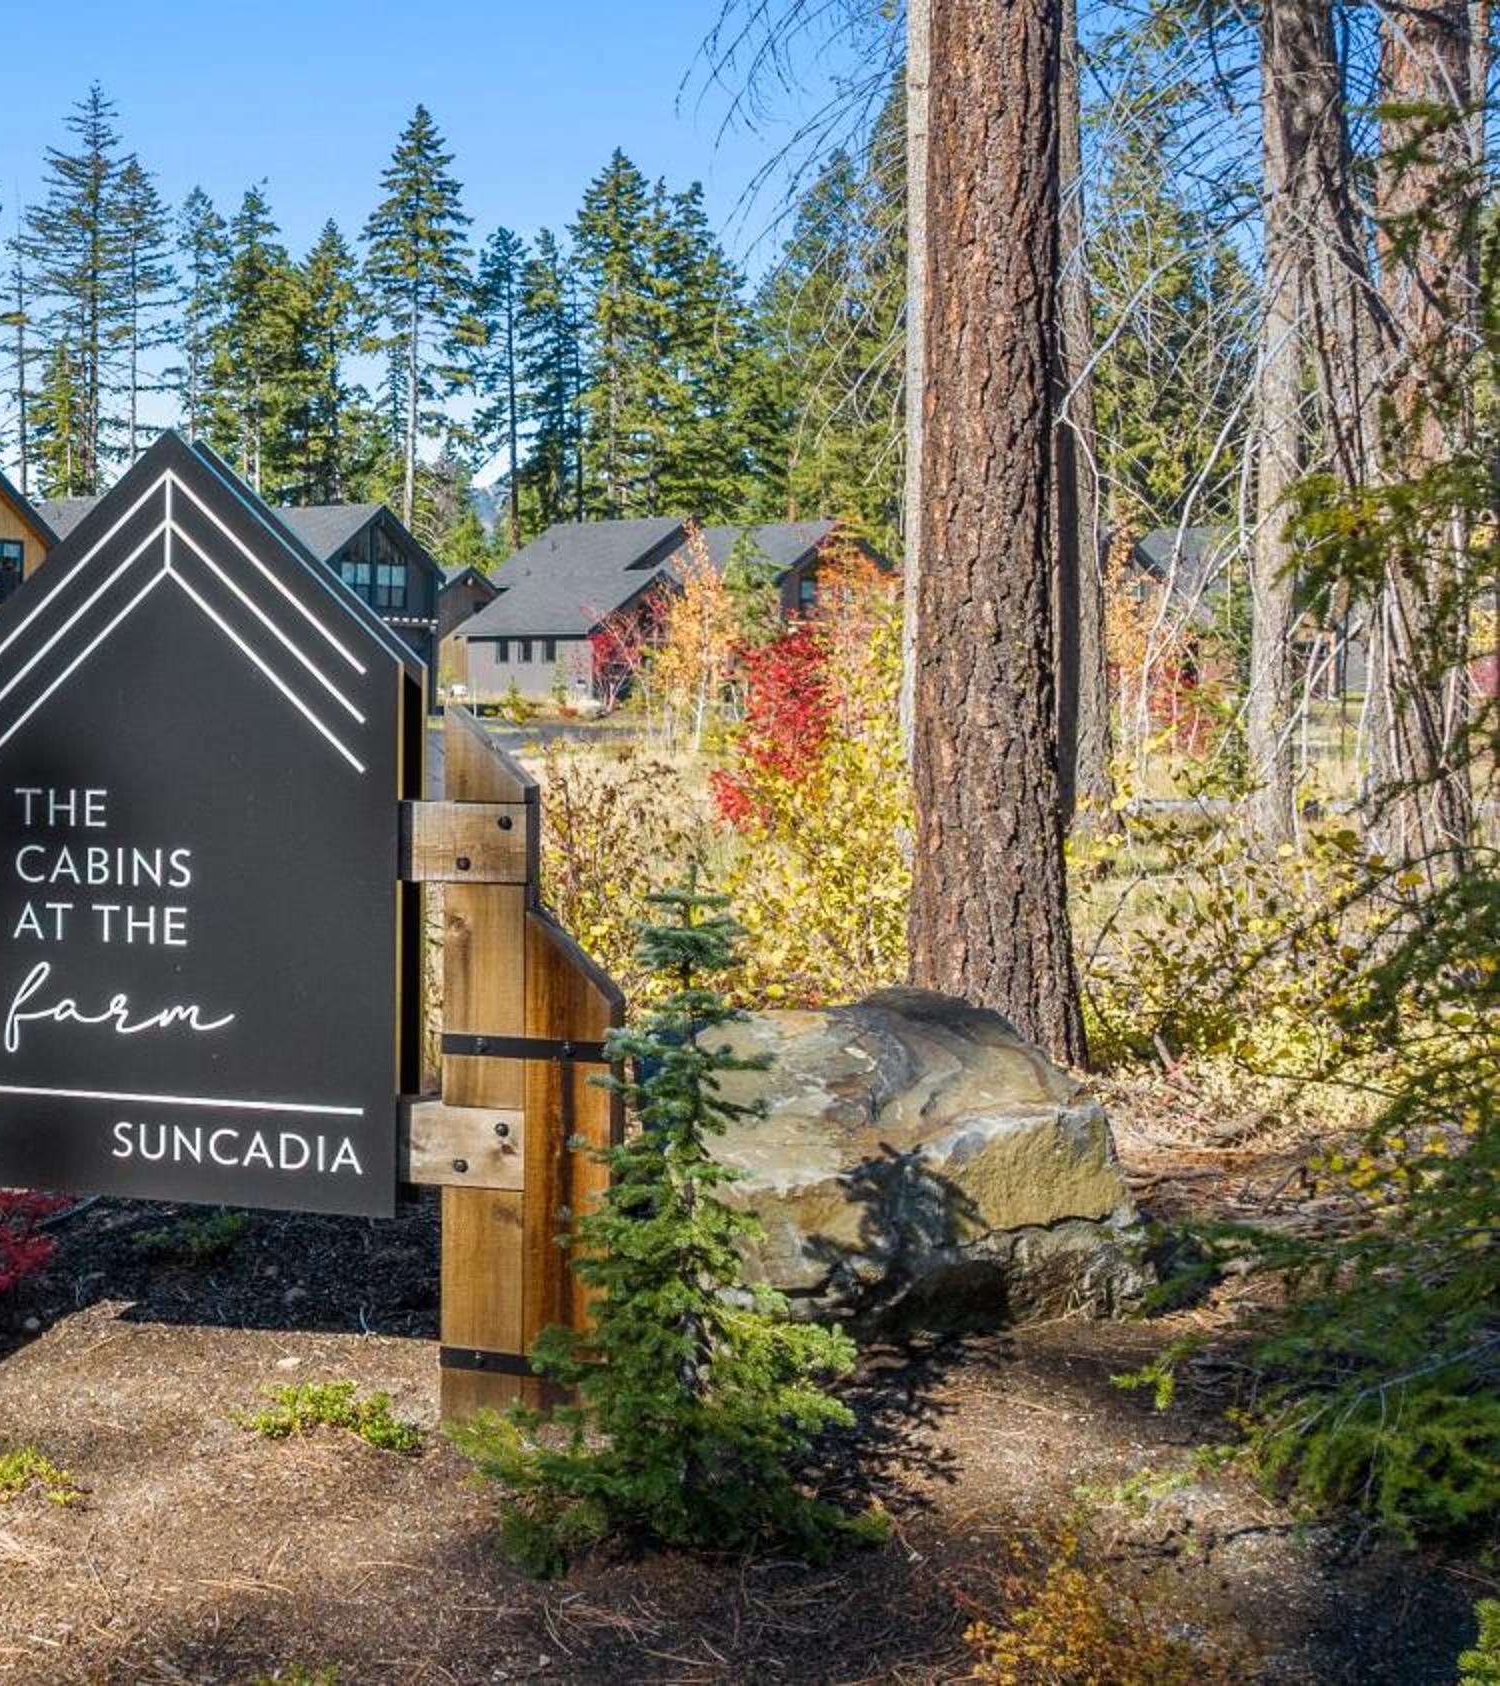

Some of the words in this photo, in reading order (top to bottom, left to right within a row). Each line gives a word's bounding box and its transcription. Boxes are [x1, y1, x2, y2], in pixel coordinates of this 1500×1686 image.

[15, 787, 108, 828] THE
[15, 845, 195, 890] CABINS
[13, 901, 75, 942] AT
[91, 904, 189, 948] THE
[4, 961, 236, 1054] farm
[112, 1120, 364, 1176] SUNCADIA
